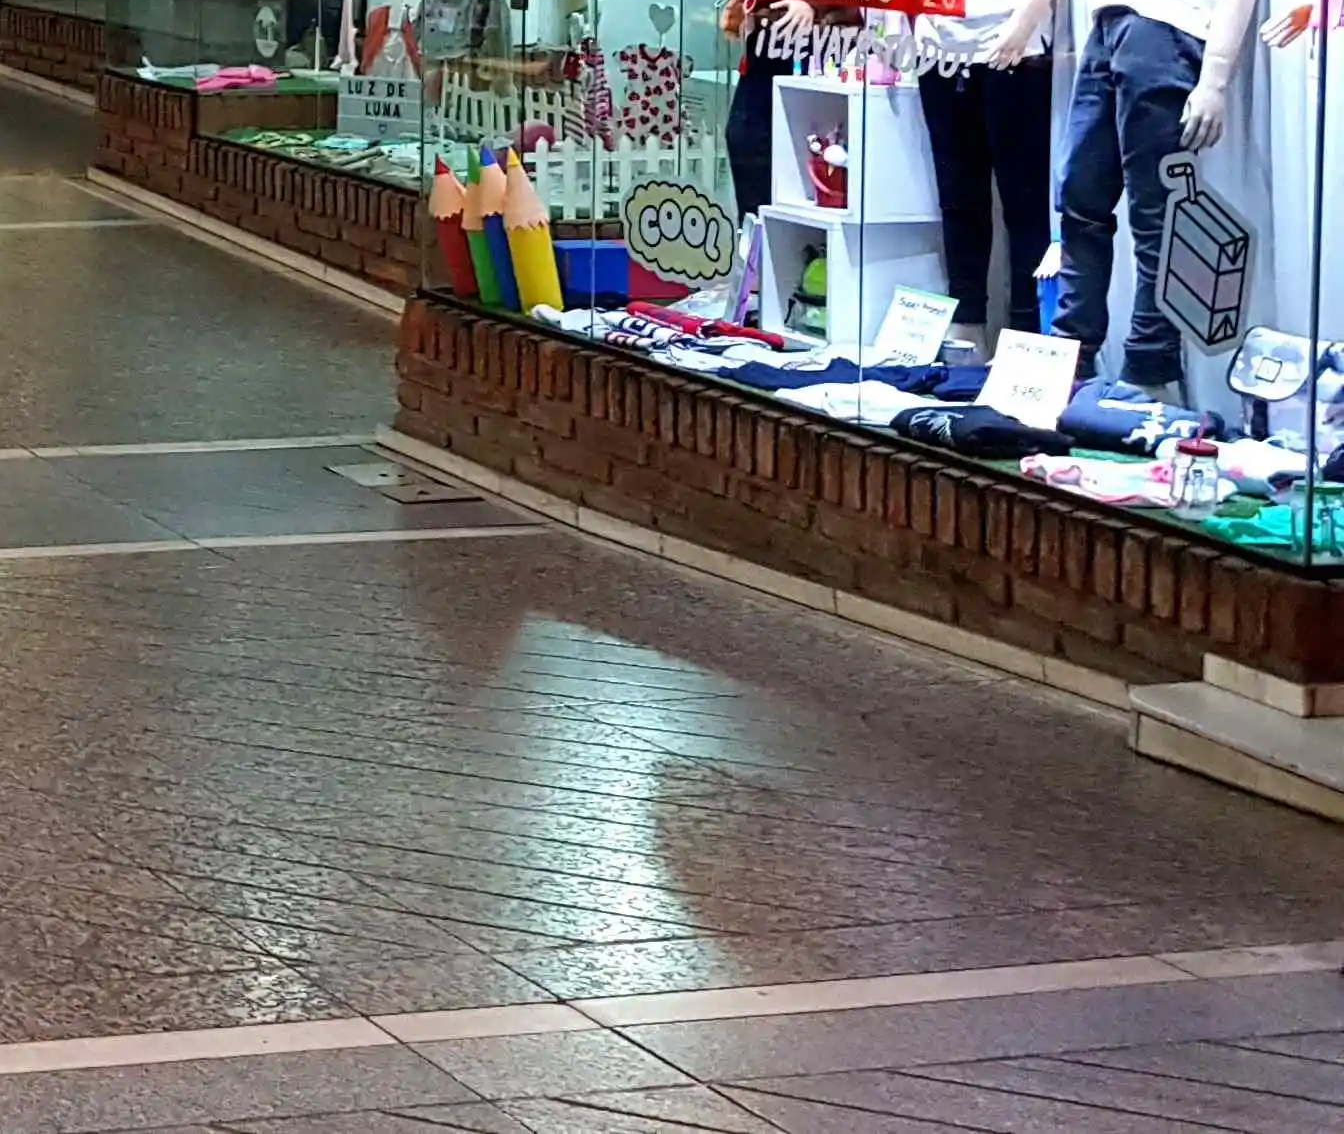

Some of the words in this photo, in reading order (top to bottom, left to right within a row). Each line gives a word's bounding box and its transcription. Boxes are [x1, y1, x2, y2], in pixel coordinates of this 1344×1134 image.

[386, 82, 405, 98] DE
[365, 101, 401, 118] LUNA
[638, 198, 721, 263] COOL
